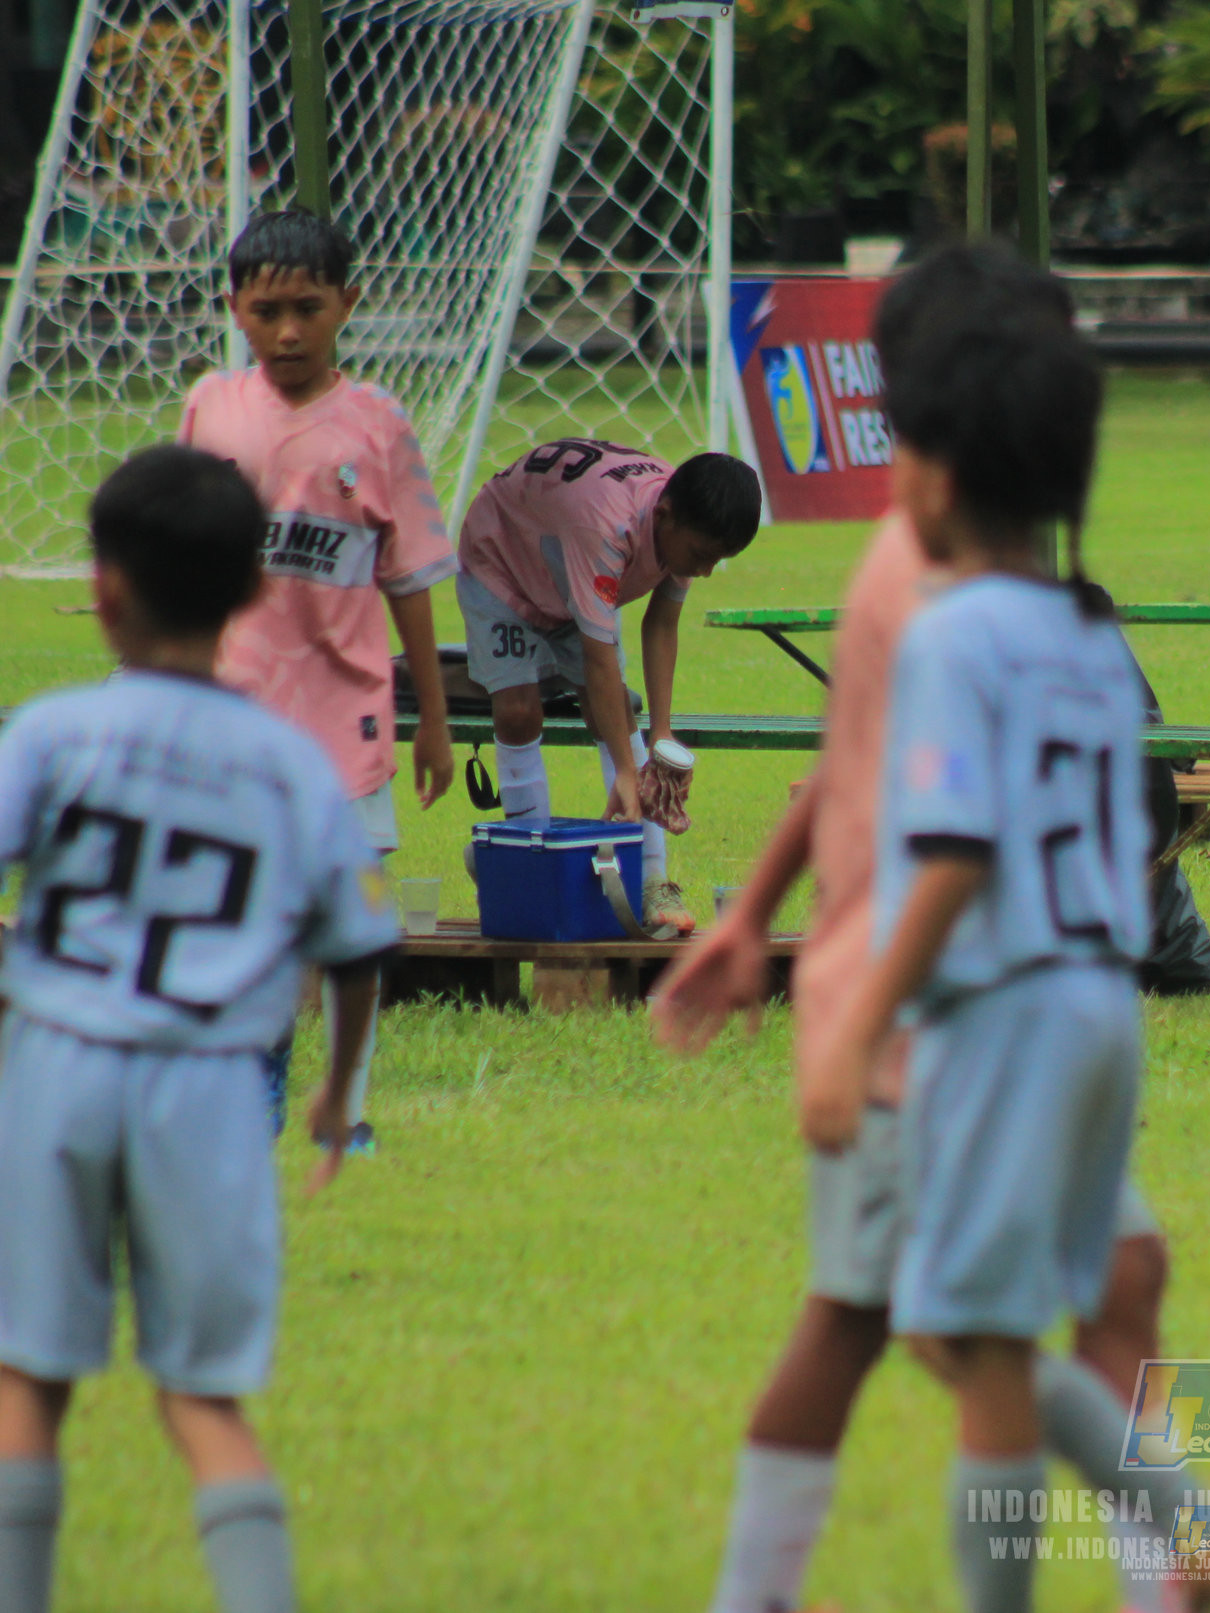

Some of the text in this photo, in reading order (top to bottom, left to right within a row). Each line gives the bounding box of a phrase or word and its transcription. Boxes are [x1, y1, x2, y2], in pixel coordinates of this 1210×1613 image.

[823, 341, 885, 398] FAIR
[839, 408, 896, 466] RES
[286, 522, 348, 559] NAZ
[491, 623, 525, 659] 36
[1039, 738, 1112, 940] 21
[40, 802, 257, 1024] 22
